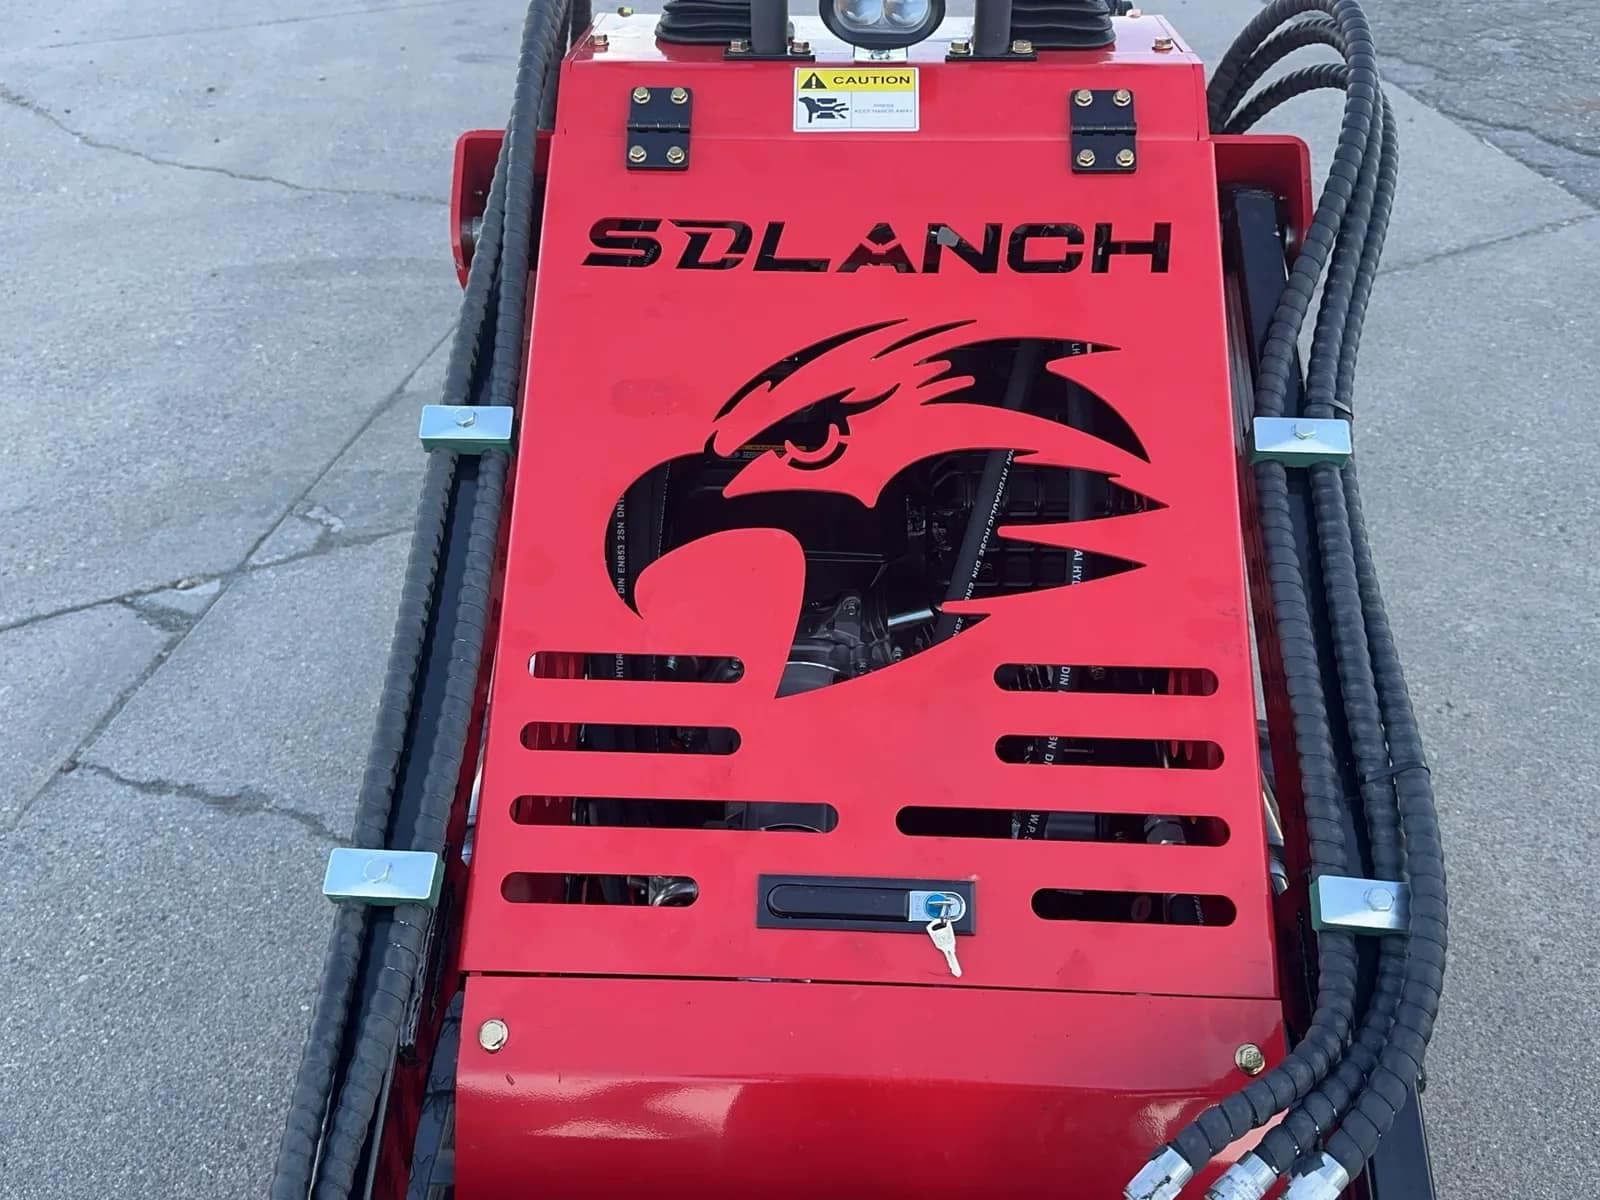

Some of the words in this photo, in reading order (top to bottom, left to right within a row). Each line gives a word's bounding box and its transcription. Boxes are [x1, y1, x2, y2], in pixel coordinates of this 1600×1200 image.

[833, 76, 911, 84] CAUTION
[581, 217, 1172, 274] SDLANCH
[987, 467, 1009, 527] HYDRAULIC
[616, 521, 625, 541] 2SN
[978, 527, 991, 557] HOSE
[617, 544, 626, 574] EN853
[971, 560, 982, 579] DIN
[617, 578, 625, 594] DIN
[1059, 666, 1071, 686] DIN
